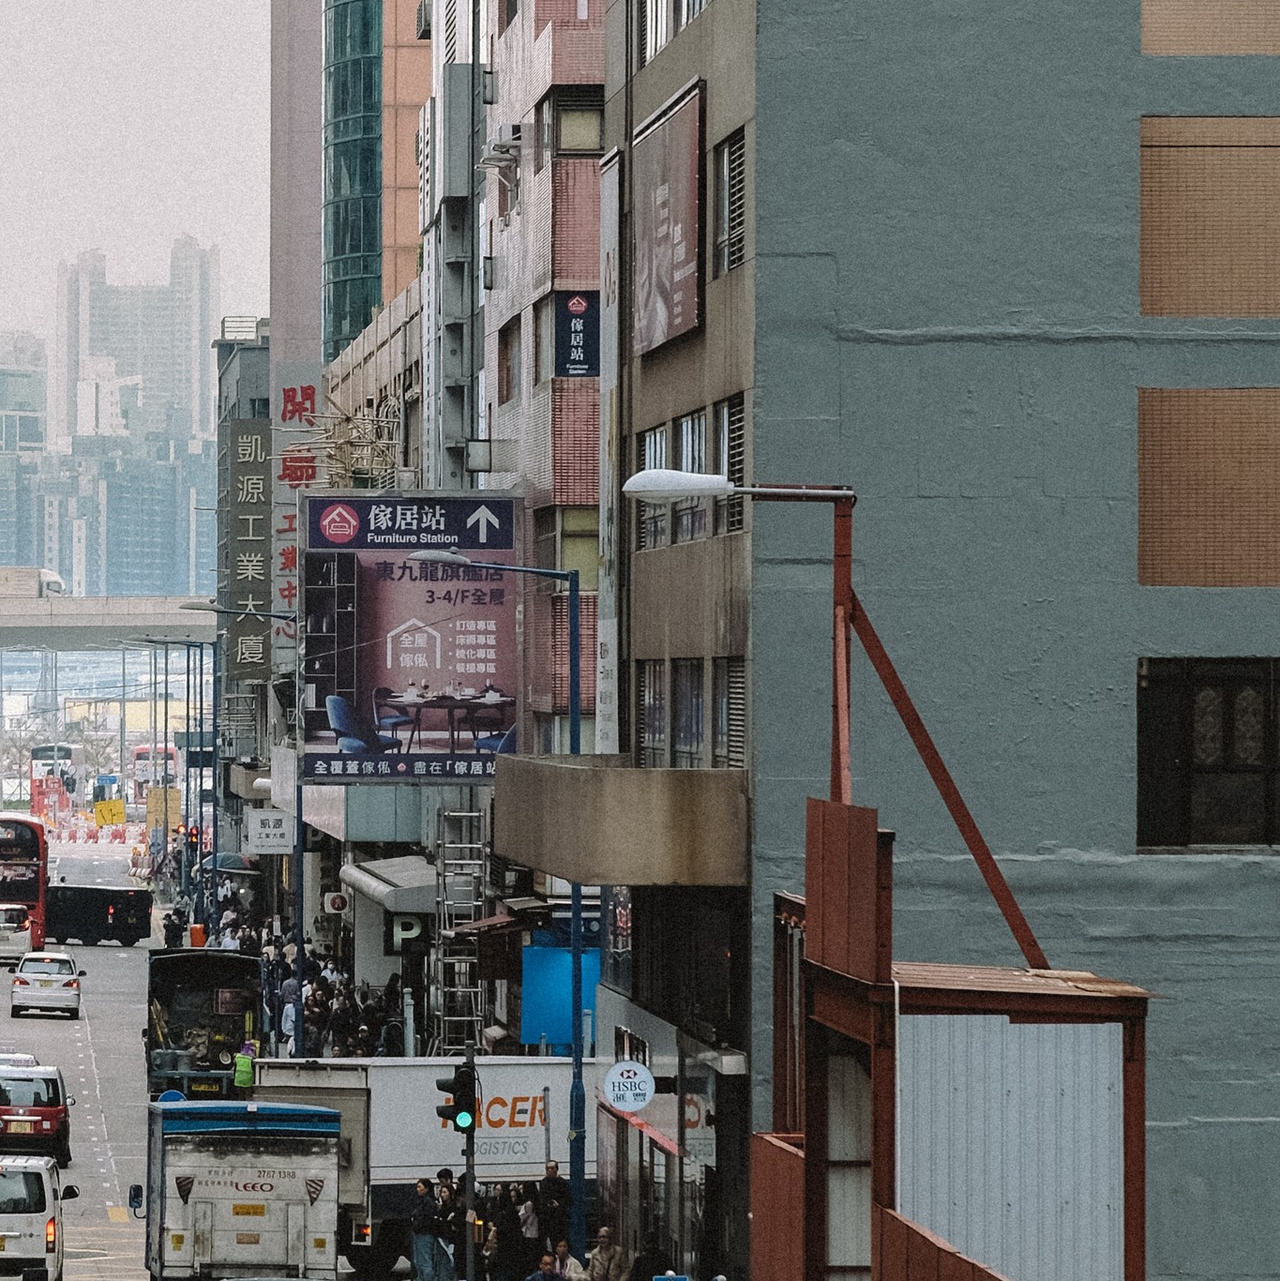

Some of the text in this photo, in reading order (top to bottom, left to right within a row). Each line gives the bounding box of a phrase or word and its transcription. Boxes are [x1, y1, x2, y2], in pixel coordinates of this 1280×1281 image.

[570, 318, 584, 360] 傢居站
[368, 504, 446, 531] 傢居站
[368, 532, 458, 543] Furniture Station
[236, 434, 266, 664] 凱源工業大廈
[375, 560, 505, 583] 東九龍旗艦店
[400, 633, 428, 648] 全屋
[393, 915, 422, 951] P
[612, 1080, 648, 1092] HSBC
[470, 1141, 529, 1156] OGISTICS
[235, 1182, 274, 1193] LEEO
